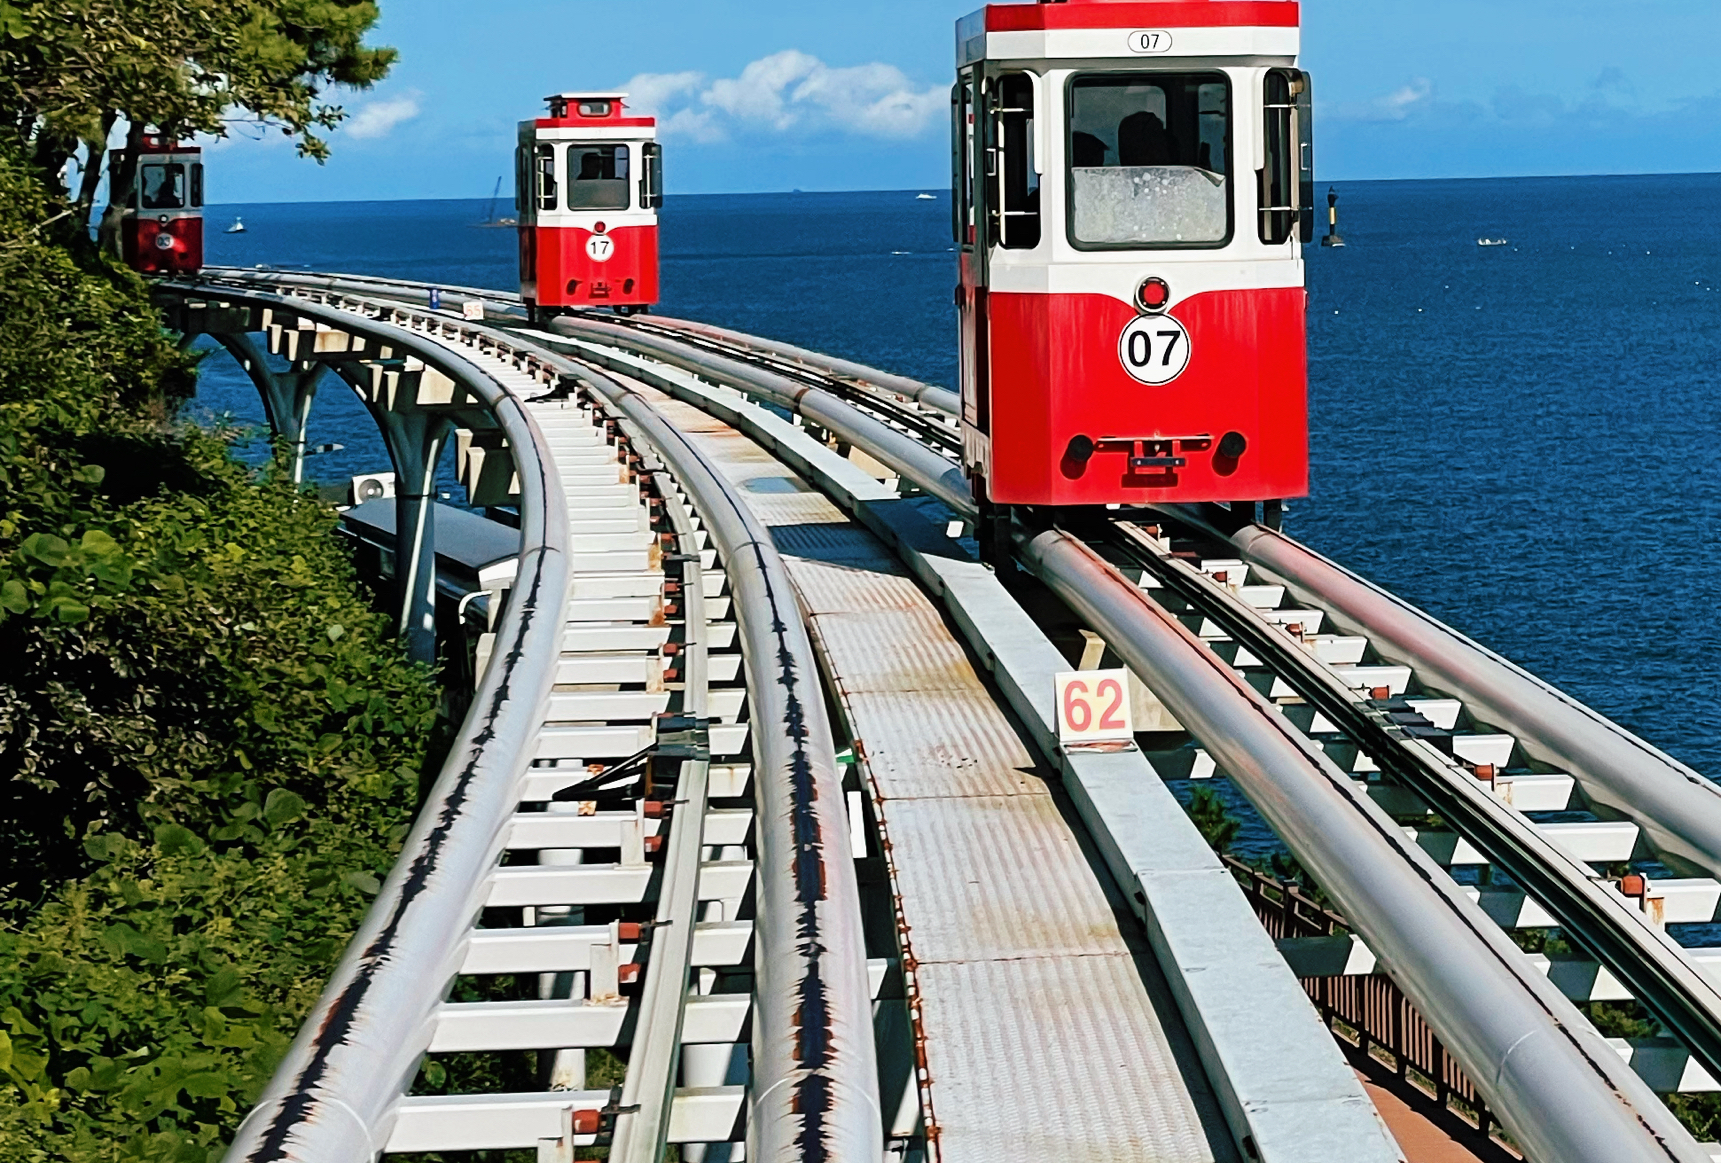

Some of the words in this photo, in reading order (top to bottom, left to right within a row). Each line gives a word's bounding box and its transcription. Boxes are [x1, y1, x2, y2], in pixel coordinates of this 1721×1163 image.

[1141, 34, 1159, 49] 07
[591, 241, 609, 254] 17
[1128, 330, 1181, 367] 07
[1064, 678, 1125, 732] 62
